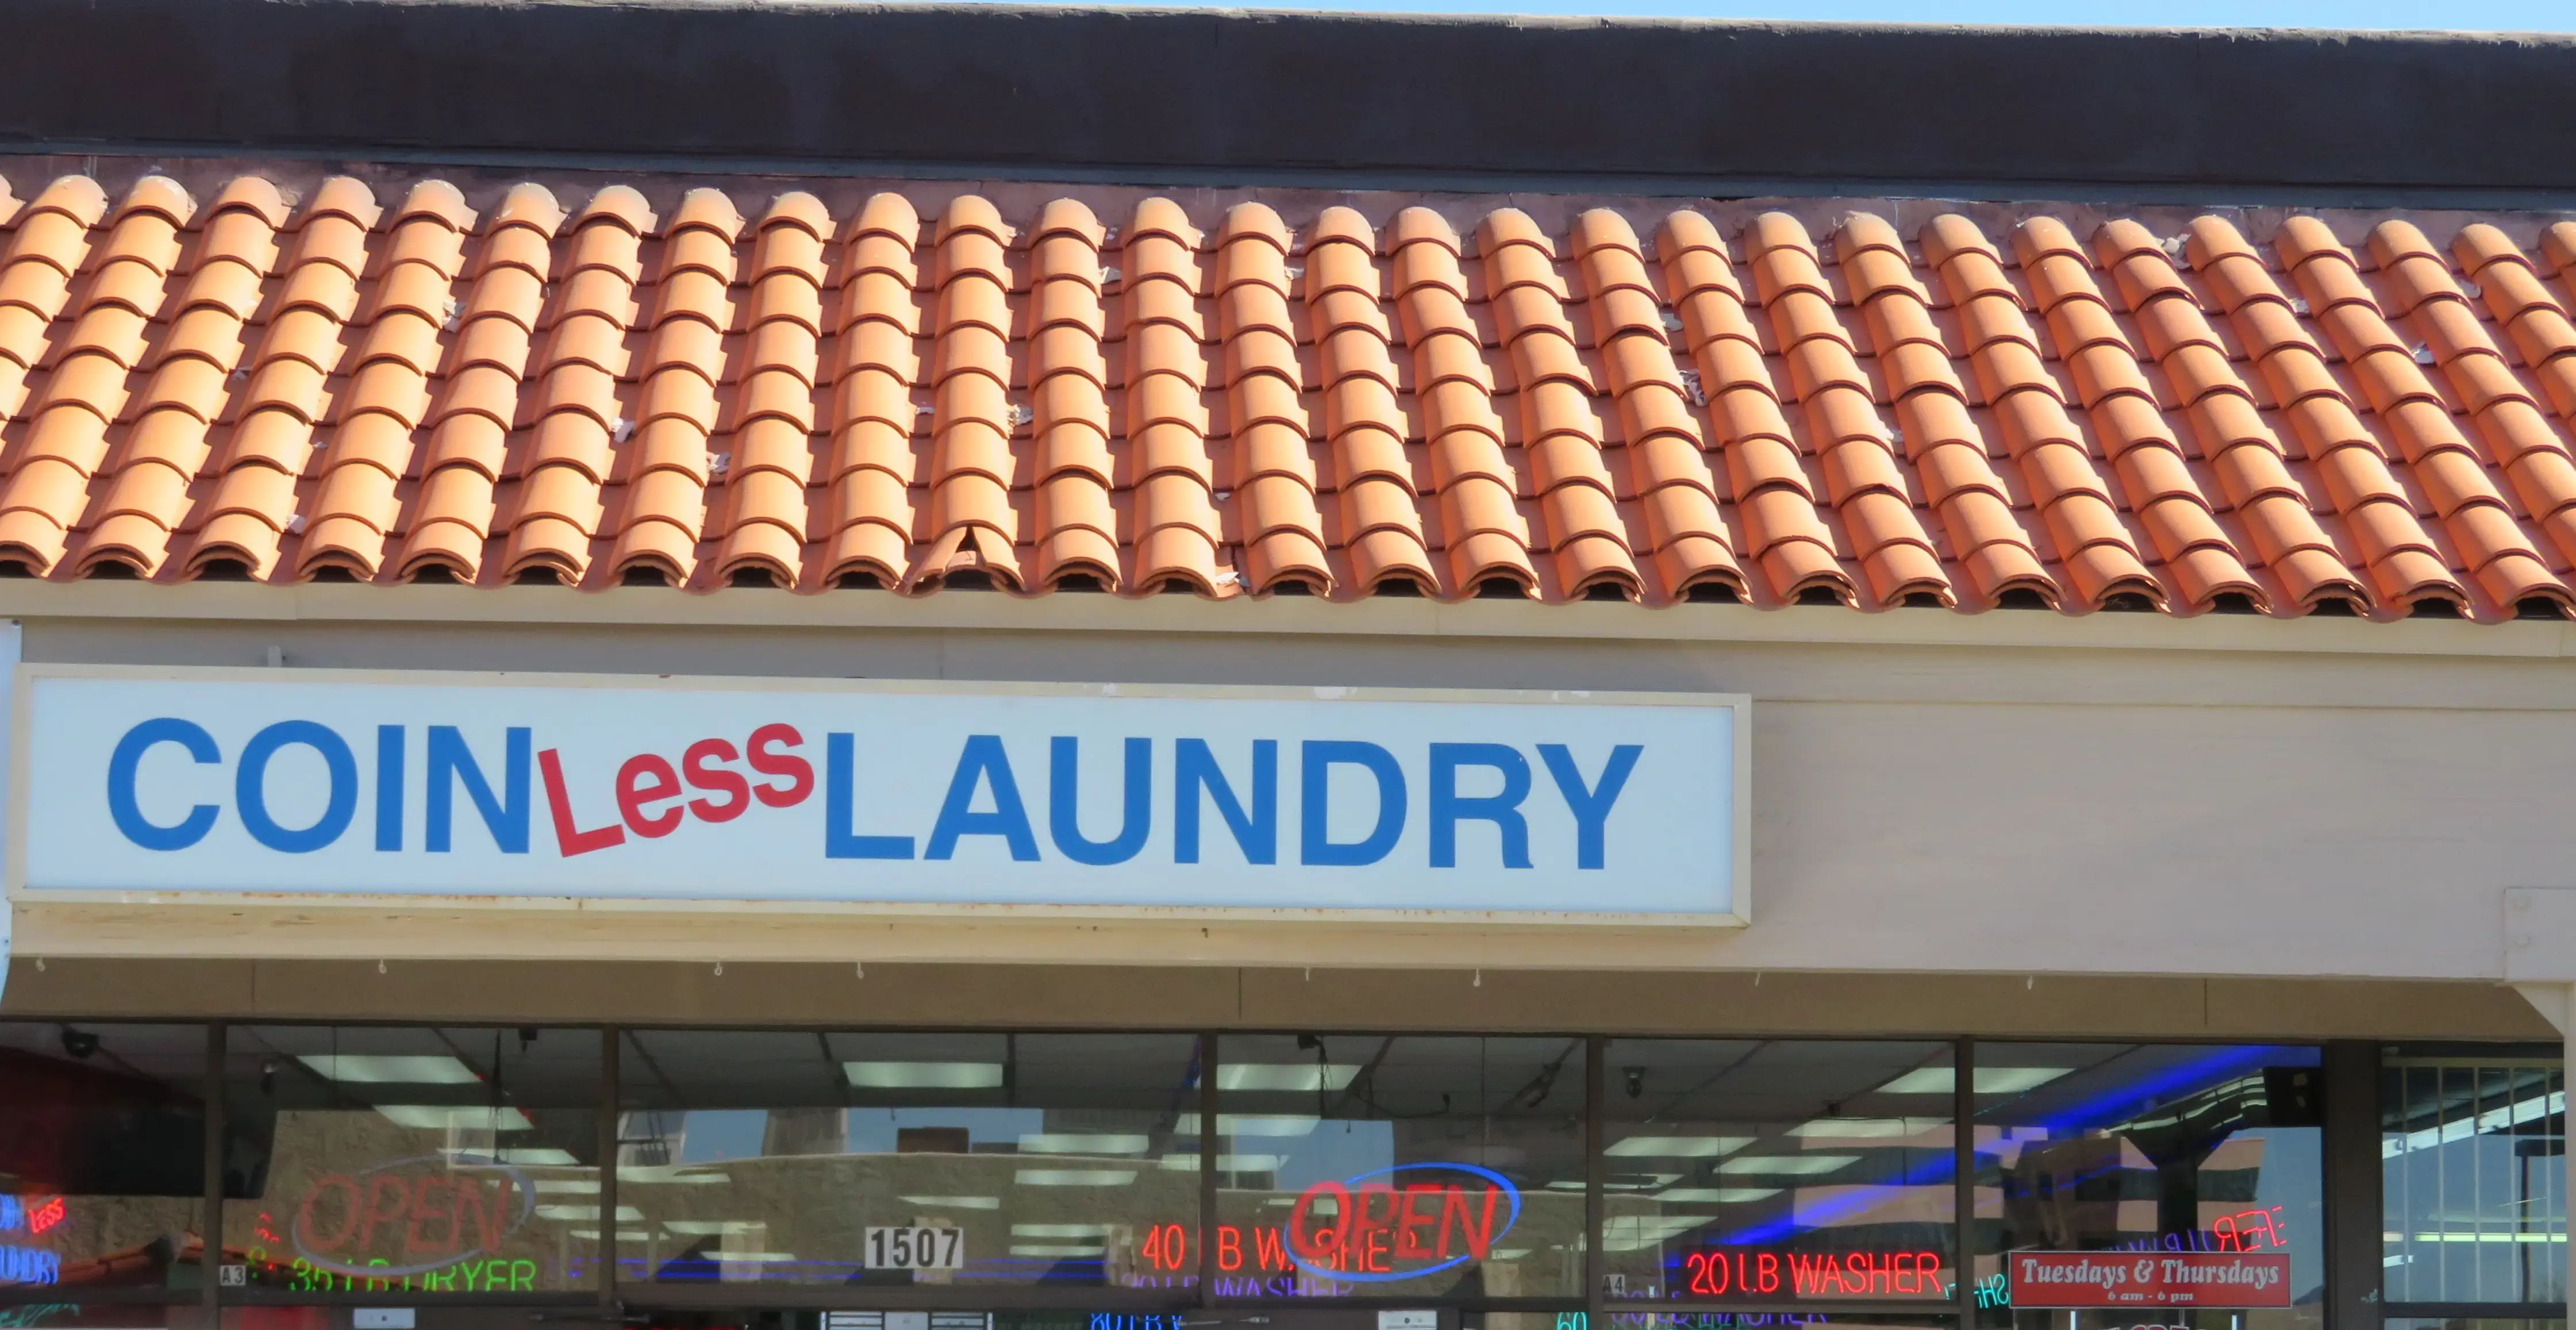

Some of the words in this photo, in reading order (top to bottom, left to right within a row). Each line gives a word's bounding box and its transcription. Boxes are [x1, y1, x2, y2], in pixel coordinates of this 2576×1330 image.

[825, 732, 1645, 870] LAUNDRY
[301, 1174, 512, 1252] OPEN
[1290, 1182, 1498, 1259] OPEN
[870, 1228, 960, 1267] 1507
[1142, 1224, 1185, 1270] 40
[221, 1267, 244, 1284] A3
[1602, 1275, 1624, 1293] A4
[1686, 1252, 1729, 1294] 20
[1737, 1252, 1779, 1294] LB
[1787, 1252, 1942, 1295] WASHER
[2022, 1259, 2127, 1290] Tuesdays
[2133, 1259, 2154, 1283] &
[2161, 1259, 2279, 1290] Thursdays
[2108, 1291, 2116, 1301] 6
[2158, 1291, 2166, 1301] 6
[2171, 1293, 2194, 1303] pm
